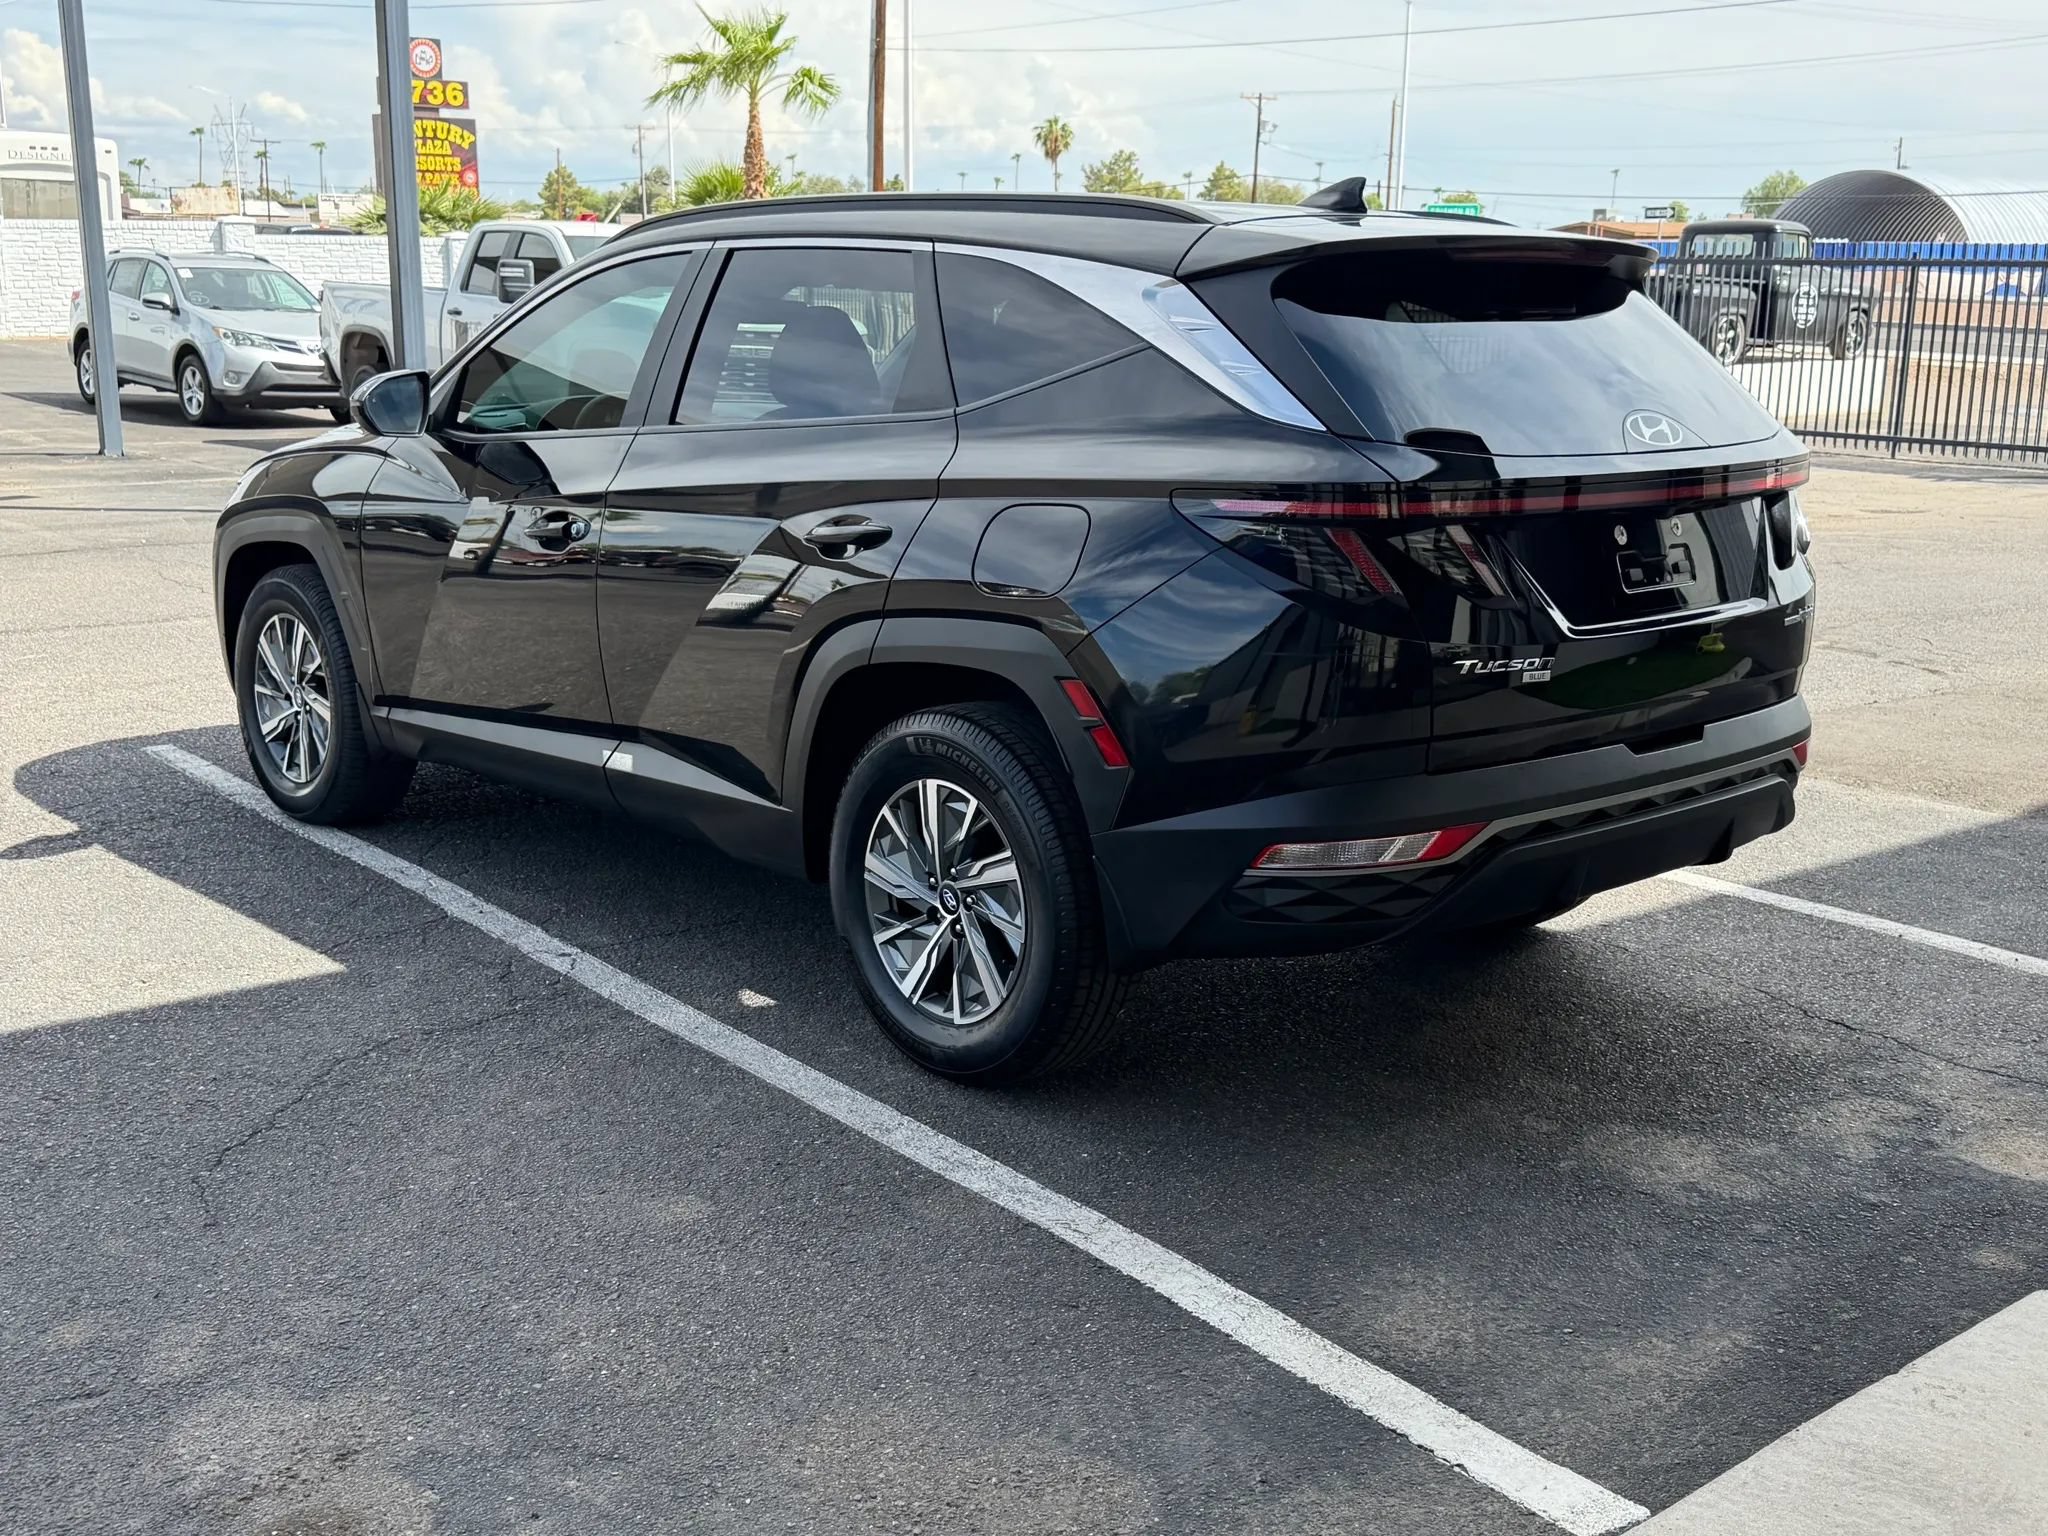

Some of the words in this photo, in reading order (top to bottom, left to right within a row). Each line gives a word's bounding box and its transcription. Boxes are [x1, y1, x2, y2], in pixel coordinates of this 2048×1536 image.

[8, 149, 72, 162] DESIGNE
[1528, 672, 1547, 681] BLUE
[935, 742, 1001, 795] MICHELIN
